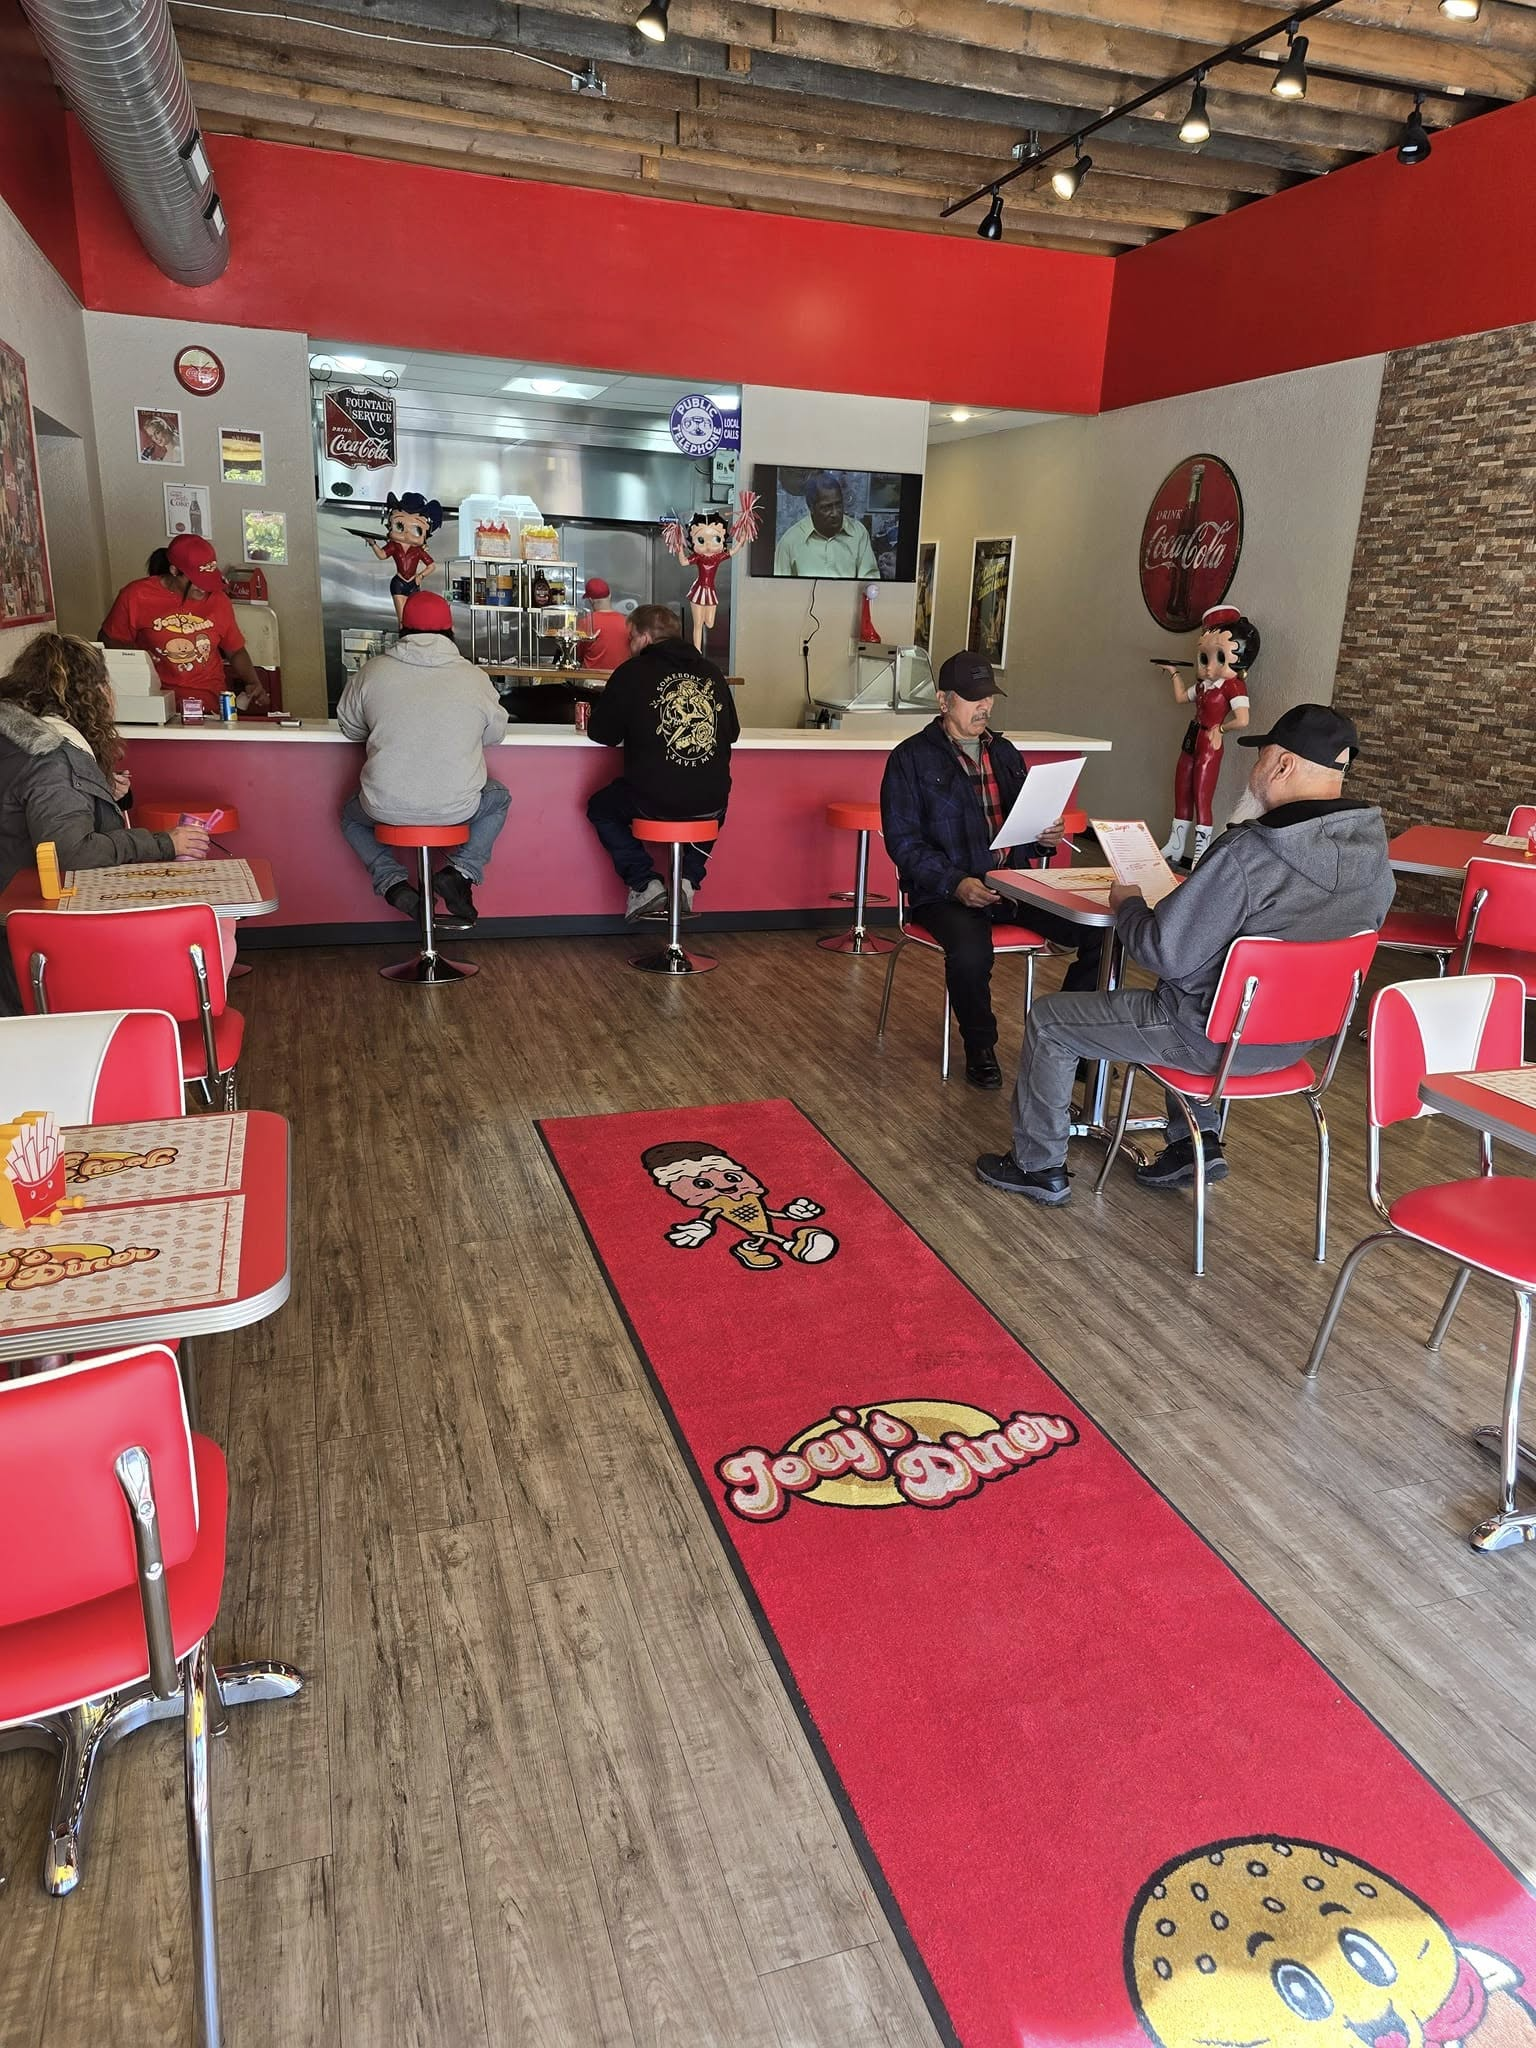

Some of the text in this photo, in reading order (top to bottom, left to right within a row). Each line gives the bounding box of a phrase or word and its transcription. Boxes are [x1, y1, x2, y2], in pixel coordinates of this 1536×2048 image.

[345, 397, 392, 411] FOUNTAIN
[677, 398, 718, 417] PUBLIC
[352, 409, 392, 435] SERVICE
[724, 418, 740, 428] LOCAL
[672, 424, 721, 454] TELEPHONE
[723, 429, 739, 440] CALLS
[330, 435, 391, 459] Coca-Cola
[1156, 509, 1183, 520] DRINK
[153, 614, 188, 631] Joey's
[656, 672, 702, 692] SOMEBODY
[669, 751, 715, 767] SAVE ME
[7, 1248, 160, 1290] Diner
[722, 1405, 1071, 1515] Joey's Diner
